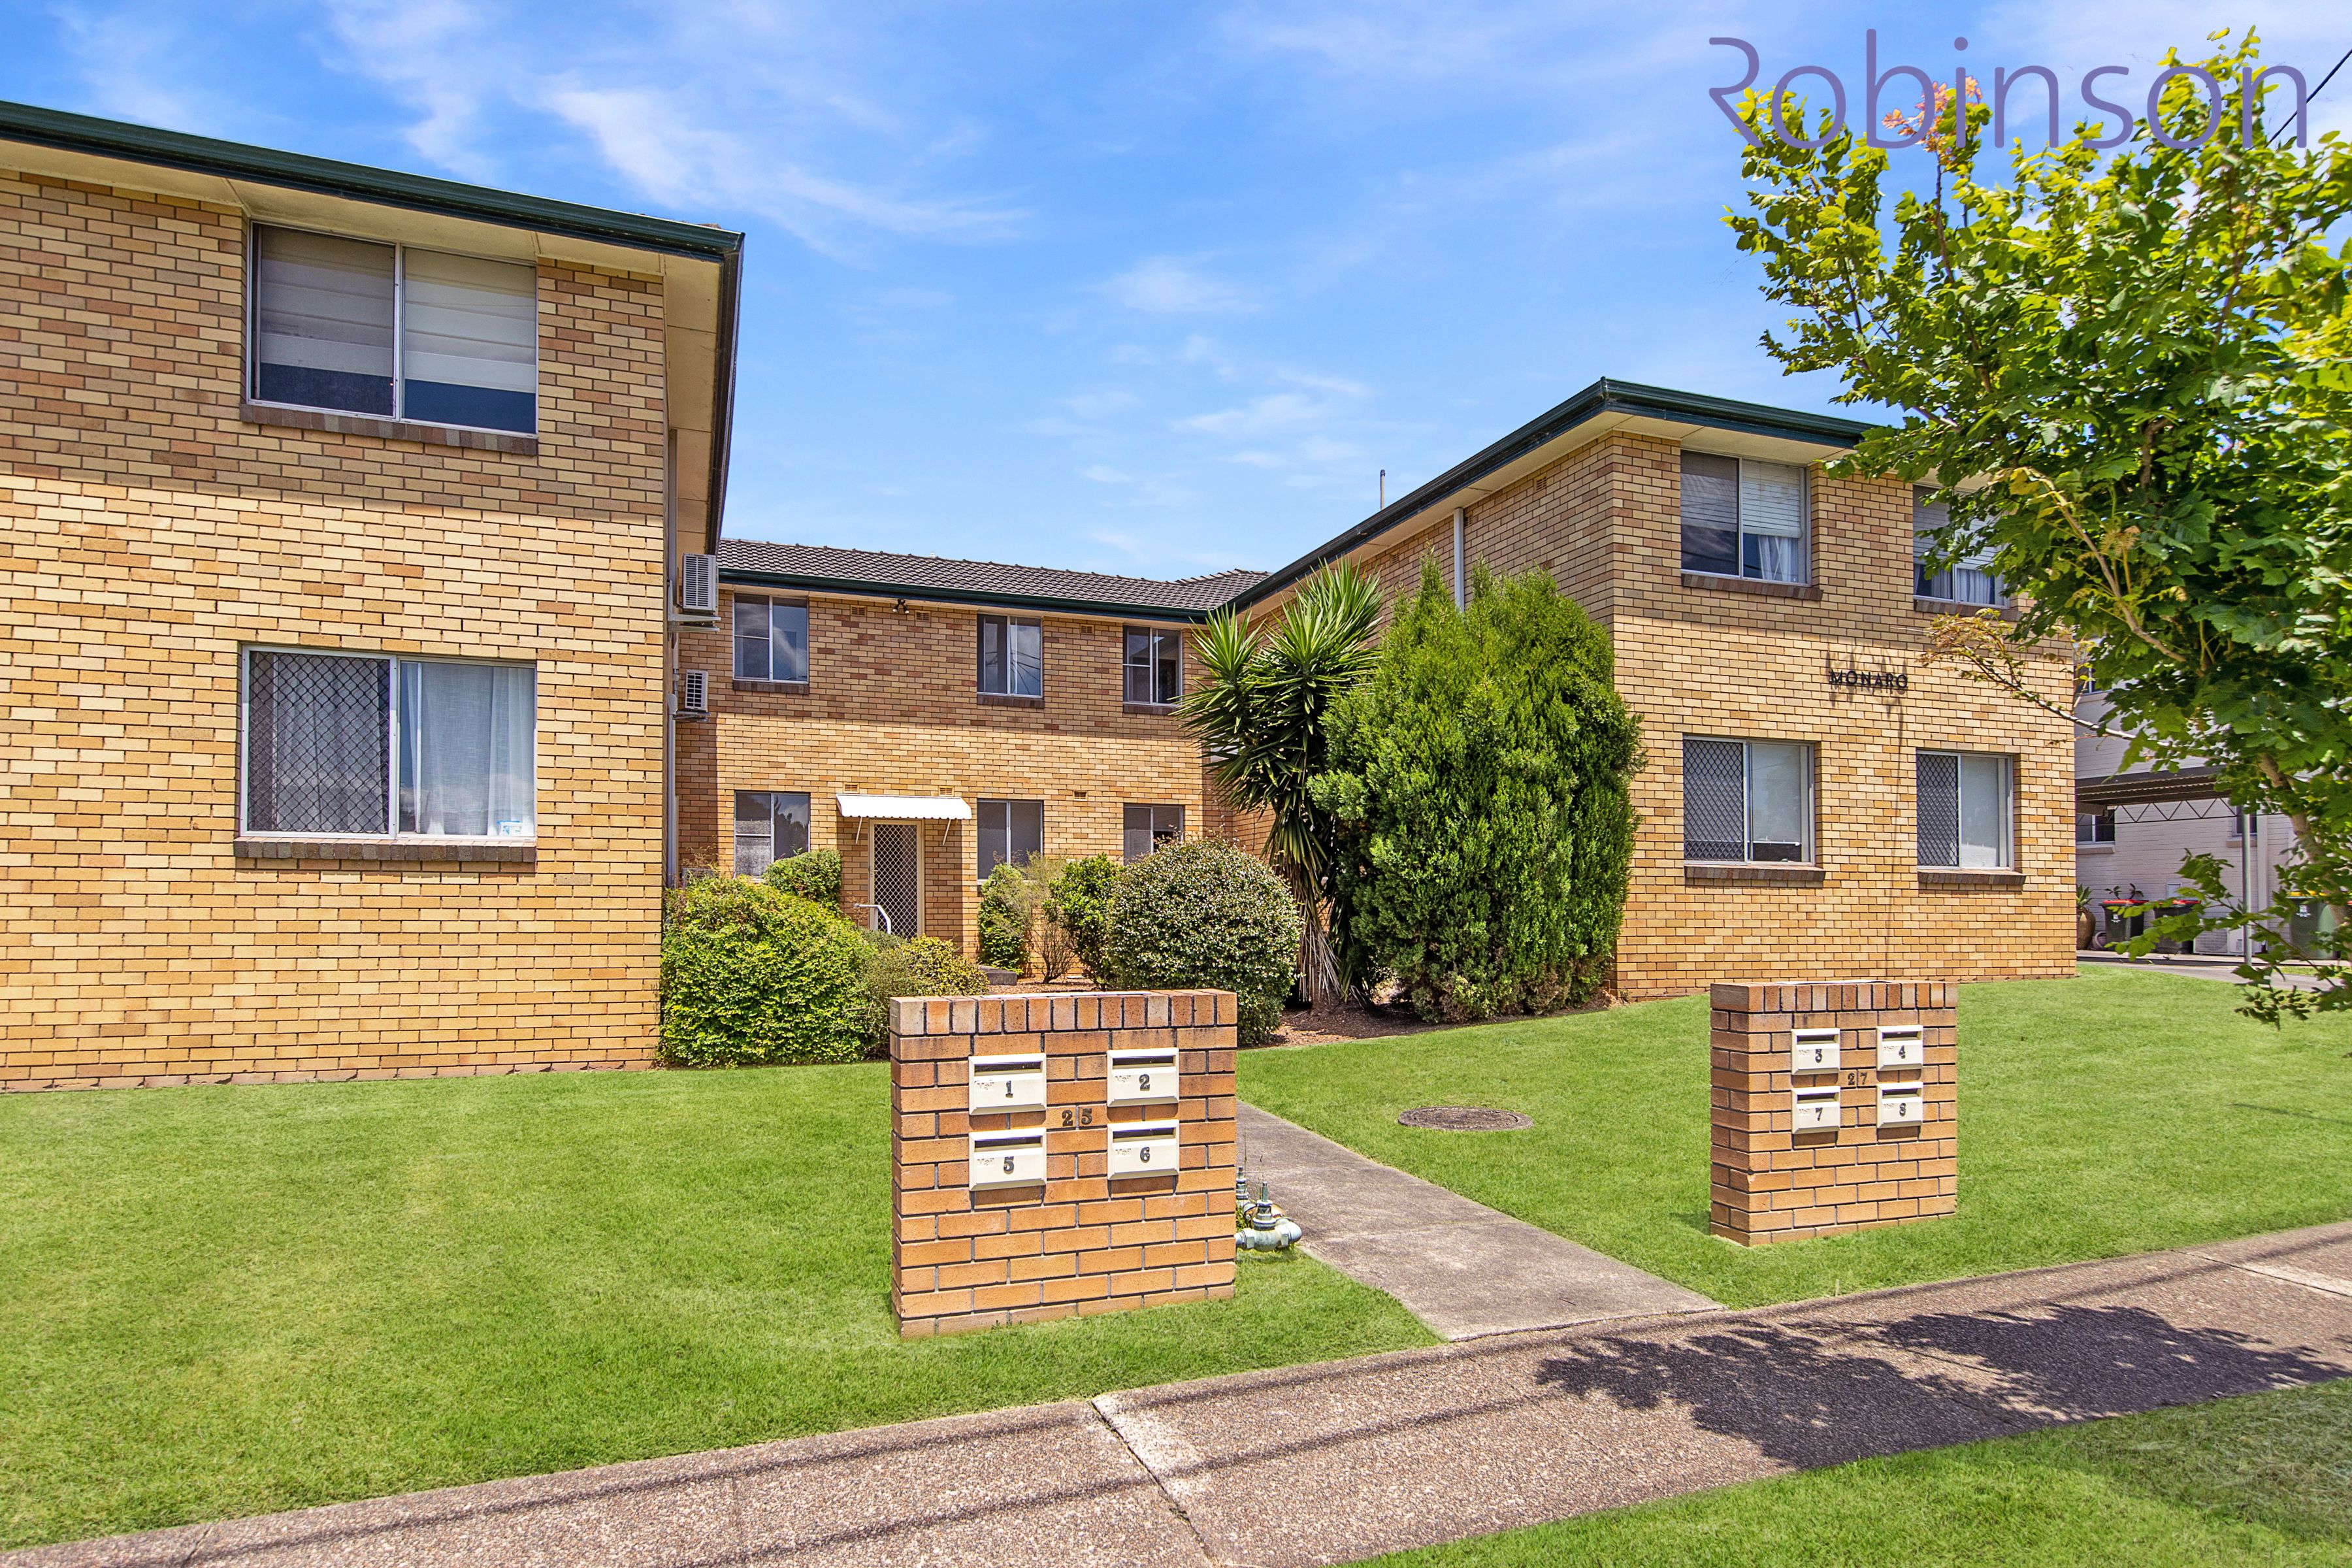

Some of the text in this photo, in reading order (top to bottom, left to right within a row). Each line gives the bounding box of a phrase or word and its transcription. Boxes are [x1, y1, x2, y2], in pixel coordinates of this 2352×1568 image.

[1829, 668, 1908, 689] MONARO
[1899, 1045, 1906, 1059] 4
[1139, 1073, 1151, 1092] 2
[1848, 1071, 1868, 1086] 27
[1005, 1080, 1013, 1098] 1
[1062, 1108, 1092, 1127] 25
[1815, 1107, 1823, 1122] 7
[1899, 1102, 1906, 1117] 8
[1139, 1147, 1150, 1164] 6
[1004, 1156, 1015, 1175] 5
